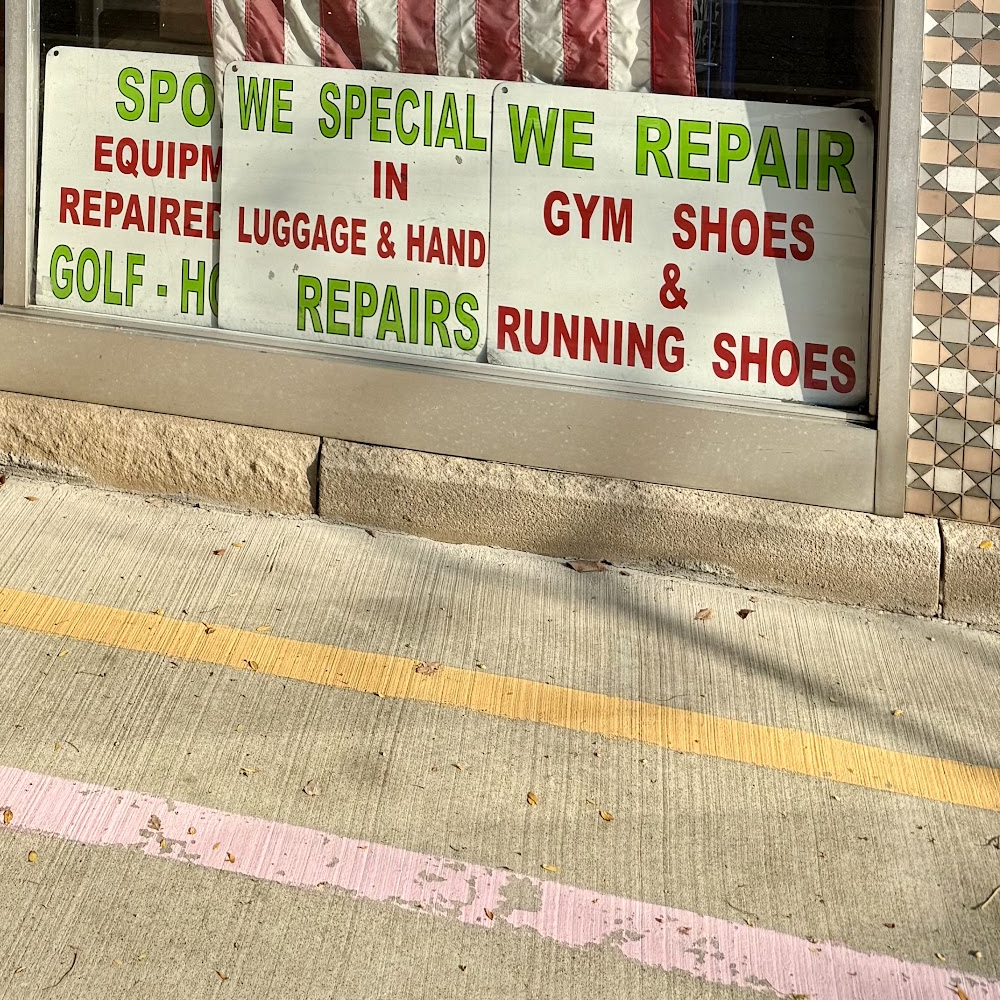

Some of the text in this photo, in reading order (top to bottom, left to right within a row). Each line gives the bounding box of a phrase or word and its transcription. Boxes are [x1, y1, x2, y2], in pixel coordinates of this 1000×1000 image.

[115, 66, 216, 128] SPO
[236, 75, 488, 152] WE SPECIAL
[93, 134, 222, 183] EQUIPM
[507, 103, 857, 194] WE REPAIR
[373, 160, 409, 201] IN
[59, 186, 221, 240] REPAIRED
[237, 206, 486, 269] LUGGAGE & HAND
[543, 190, 815, 262] GYM SHOES
[49, 244, 146, 307] GOLF
[659, 262, 688, 310] &
[296, 274, 480, 352] REPAIRS
[496, 305, 857, 394] RUNNING SHOES
